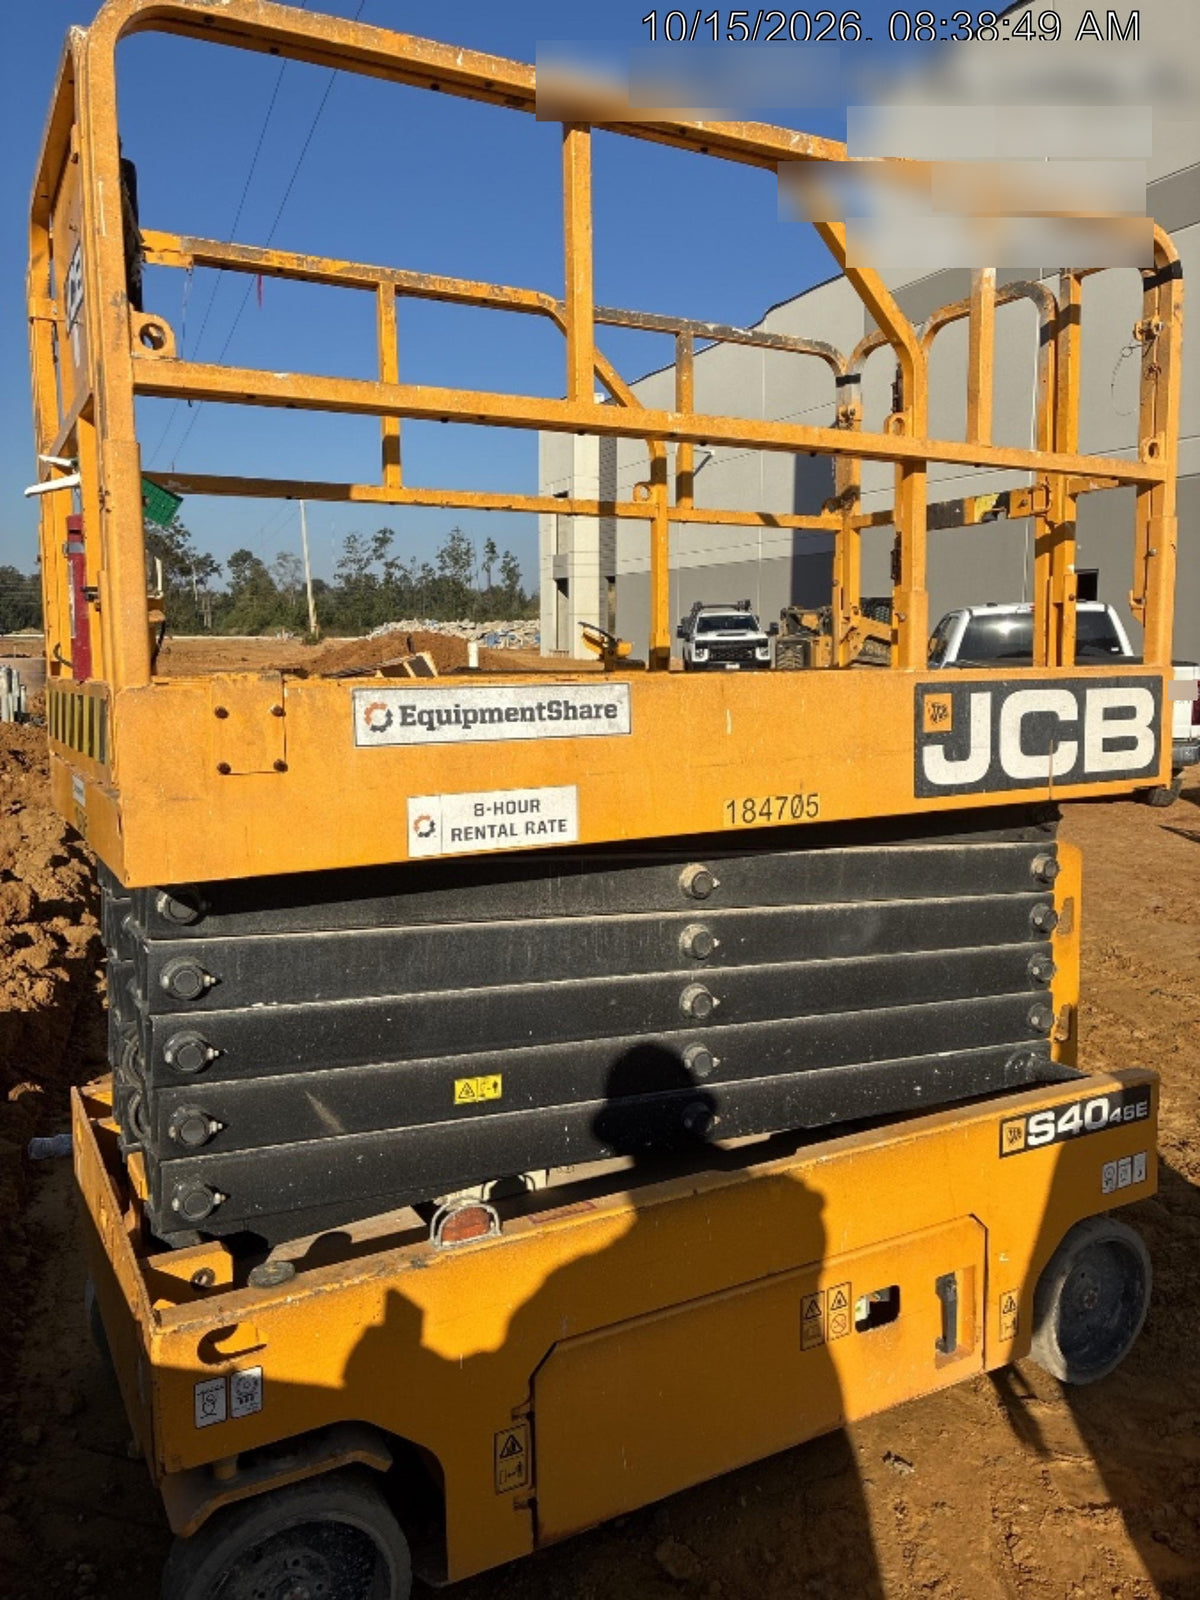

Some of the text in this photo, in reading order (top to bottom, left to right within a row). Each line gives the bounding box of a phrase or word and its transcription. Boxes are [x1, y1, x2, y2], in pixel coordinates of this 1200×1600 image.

[398, 700, 618, 731] EquipmentShare
[922, 687, 1155, 785] JCB
[473, 799, 541, 817] 8-HOUR
[726, 793, 819, 825] 184705
[450, 818, 568, 842] RENTAL RATE
